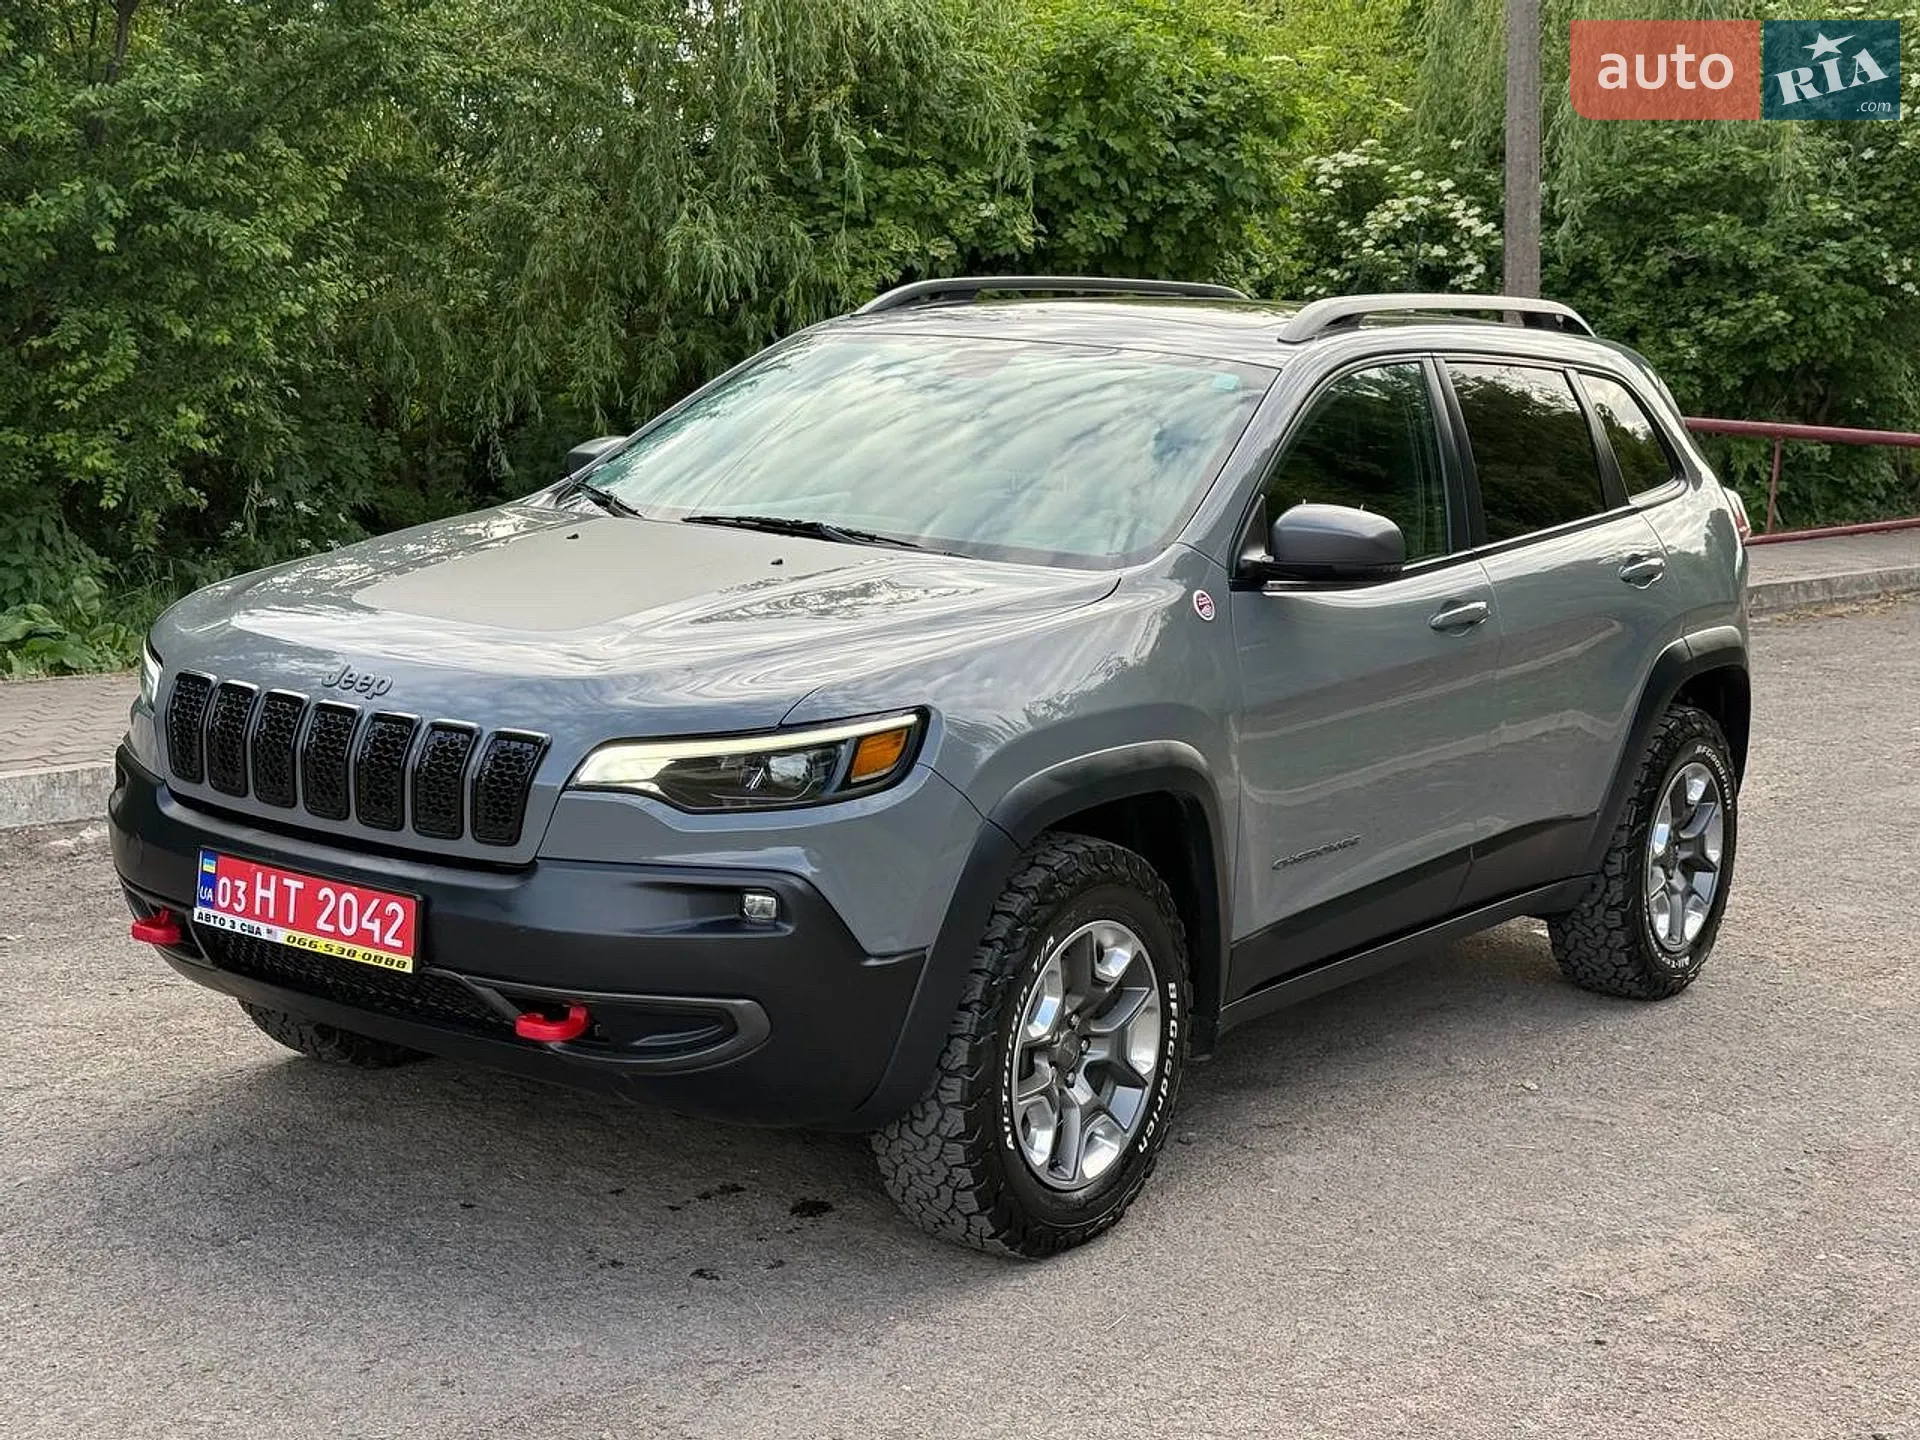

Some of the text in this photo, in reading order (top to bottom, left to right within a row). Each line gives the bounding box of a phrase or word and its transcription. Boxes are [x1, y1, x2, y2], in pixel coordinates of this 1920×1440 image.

[321, 663, 394, 700] Jeep
[199, 885, 214, 902] UA
[196, 909, 226, 928] АВТО
[216, 876, 248, 914] 03
[315, 886, 406, 949] 2042
